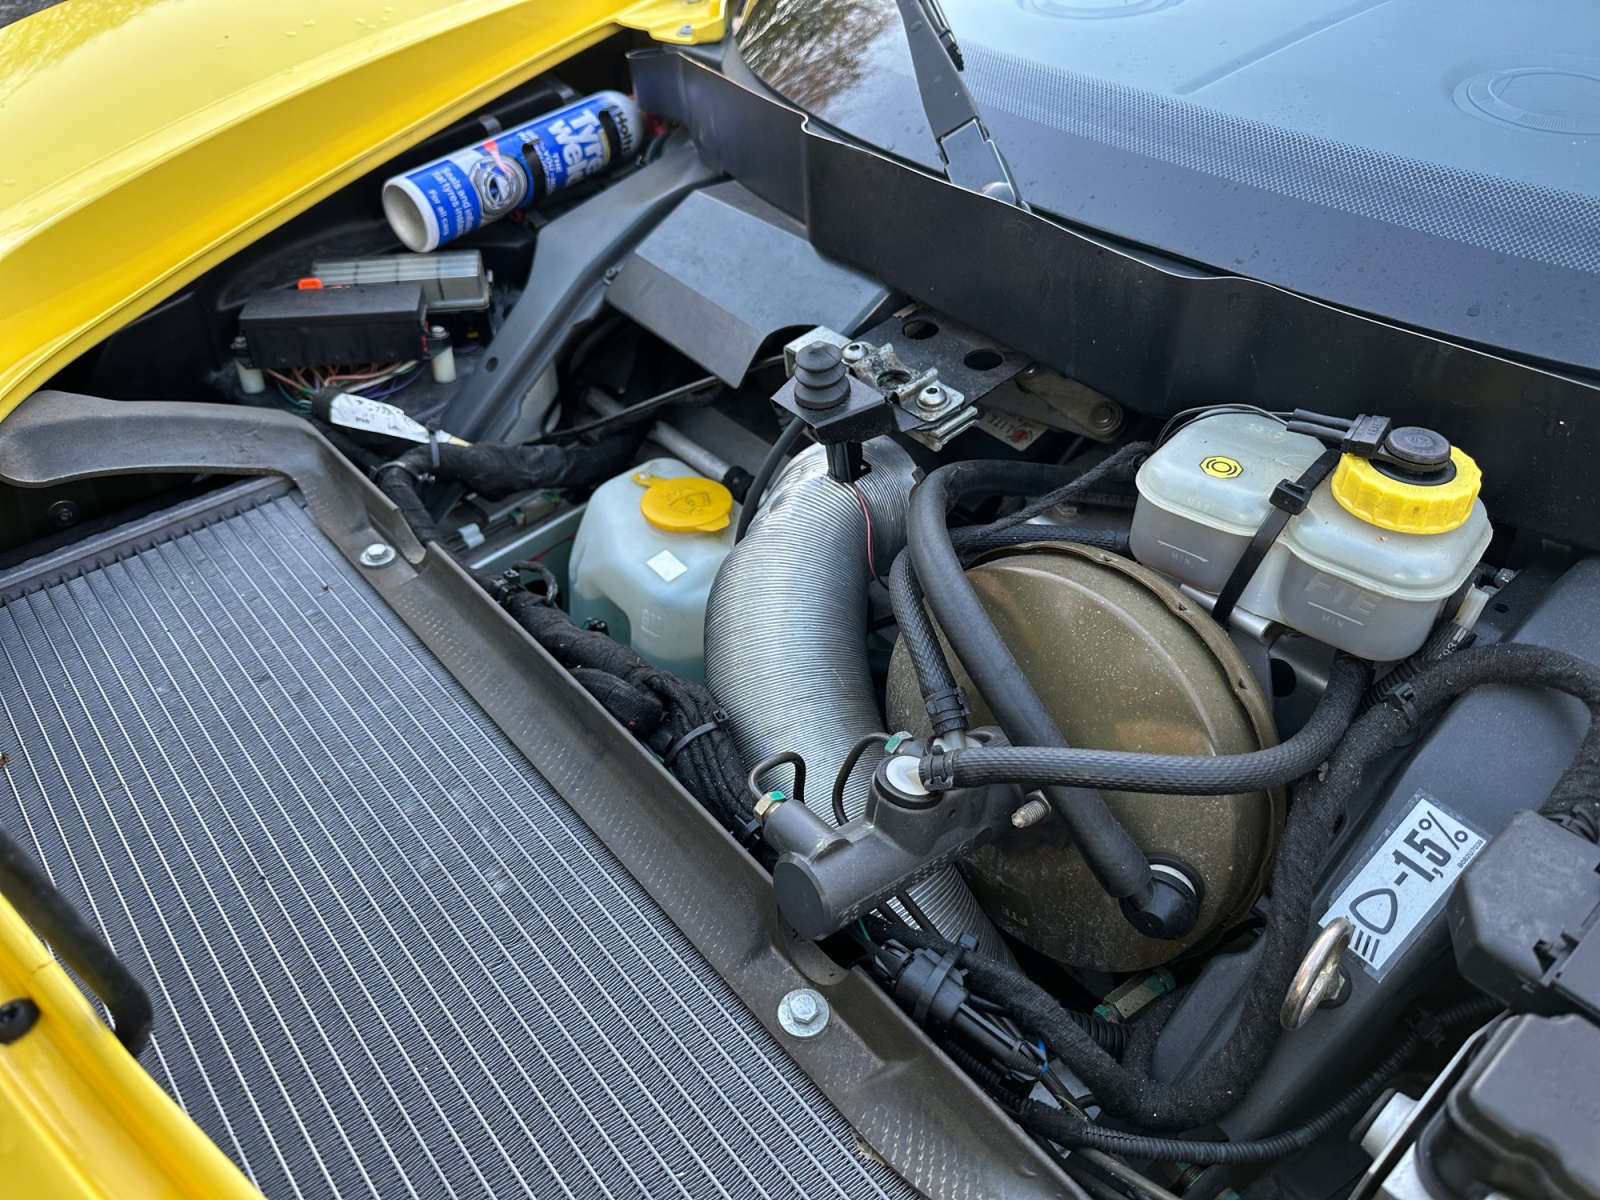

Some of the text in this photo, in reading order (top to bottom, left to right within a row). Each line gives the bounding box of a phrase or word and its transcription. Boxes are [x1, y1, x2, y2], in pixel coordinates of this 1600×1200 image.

[565, 110, 603, 175] Tyre
[614, 111, 633, 153] Holts
[553, 151, 563, 173] THE
[441, 168, 461, 190] Seals
[457, 190, 472, 209] and
[442, 183, 460, 207] tyres
[428, 189, 441, 204] For
[437, 206, 447, 218] all
[1172, 552, 1191, 566] MIN
[1304, 573, 1382, 615] FTE
[1321, 614, 1344, 629] MIN
[1392, 811, 1468, 886] -1,5%
[1002, 906, 1029, 926] FTE
